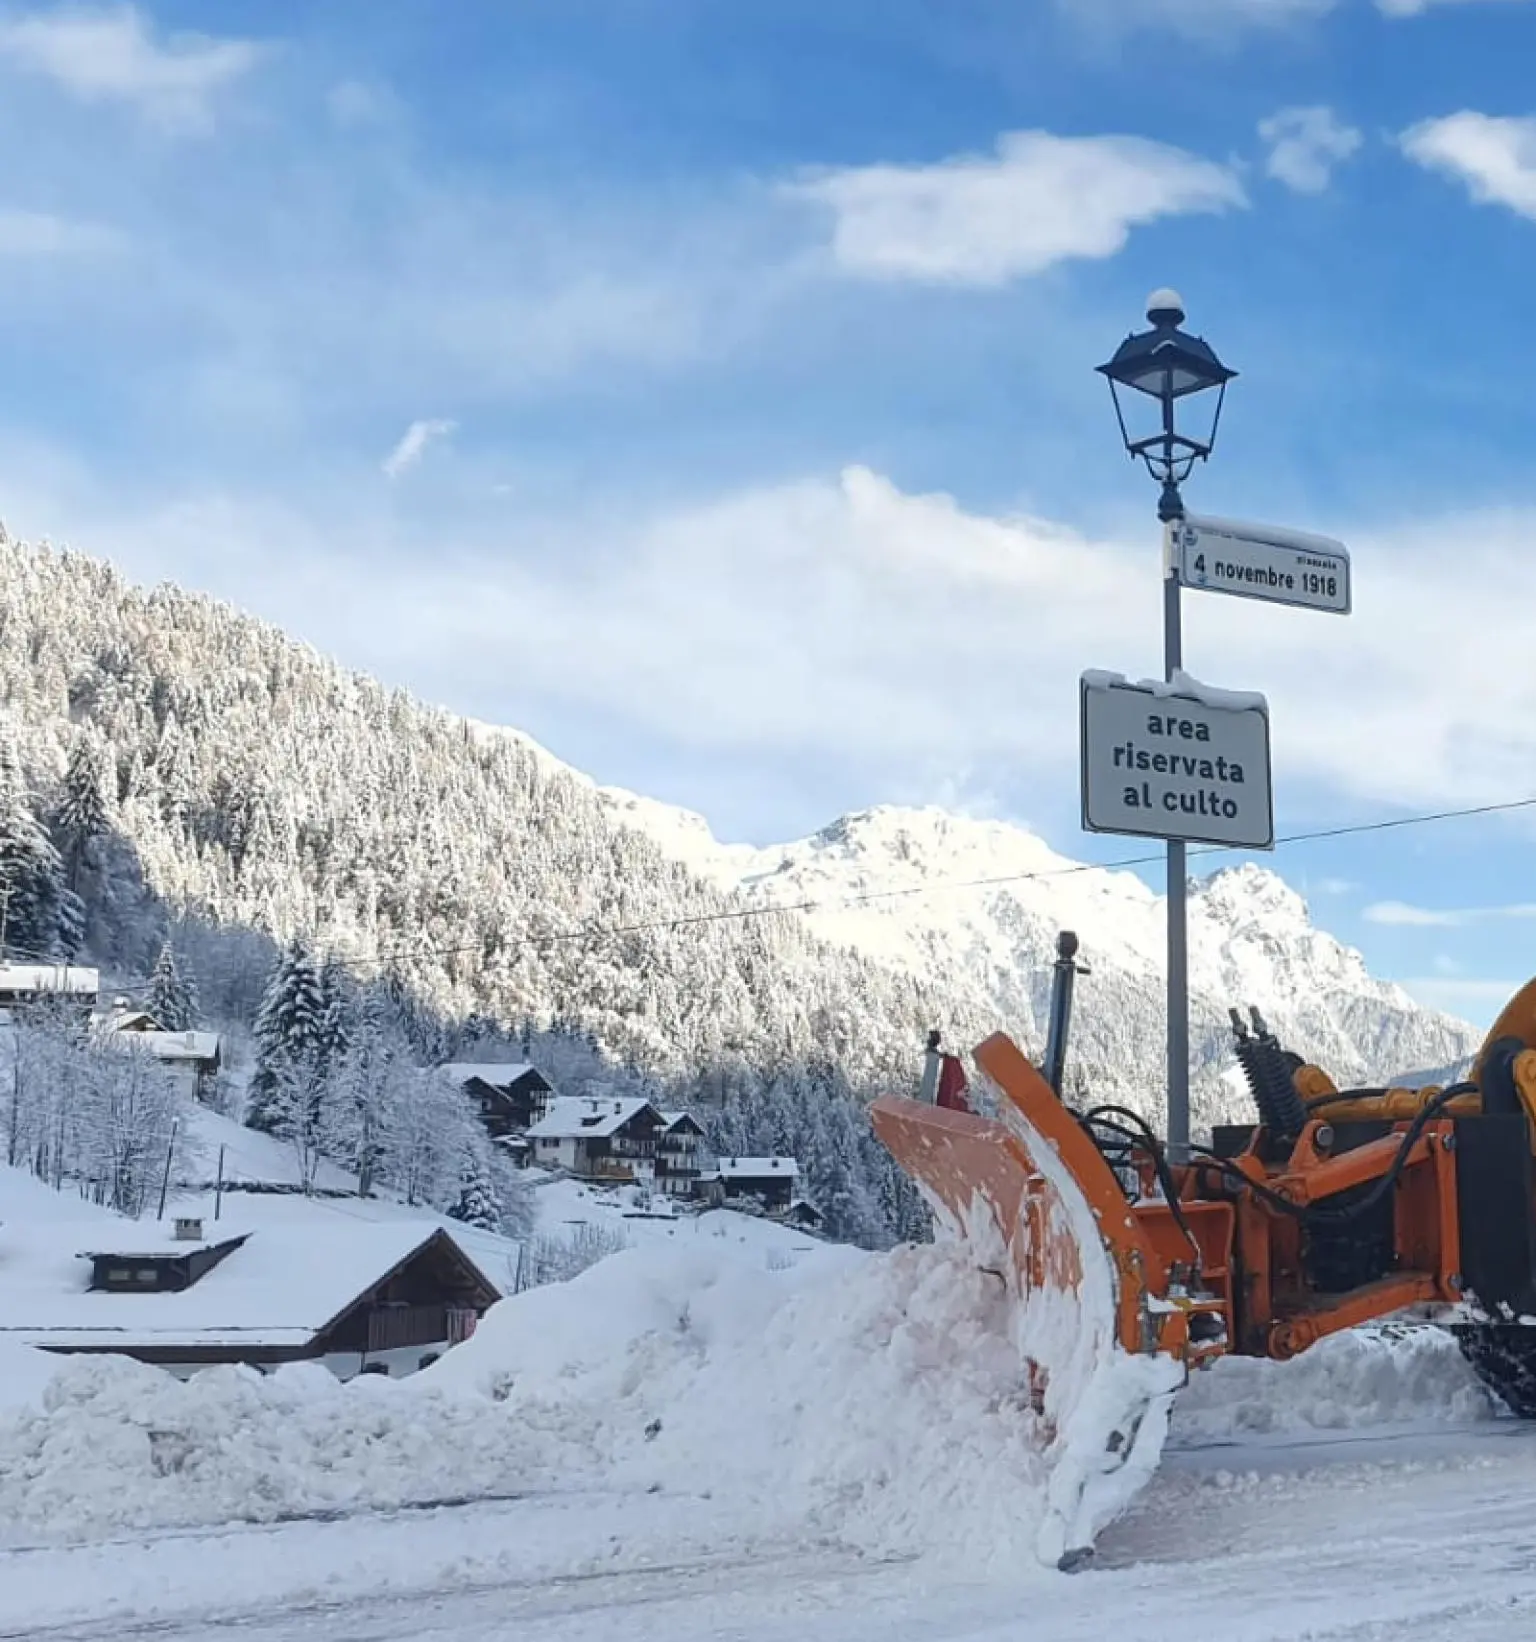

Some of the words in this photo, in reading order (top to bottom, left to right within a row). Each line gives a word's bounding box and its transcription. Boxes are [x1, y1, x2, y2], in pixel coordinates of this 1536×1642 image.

[1194, 554, 1205, 573] 4
[1214, 560, 1294, 590] novembre
[1302, 572, 1337, 598] 1918
[1147, 714, 1211, 742] area
[1112, 741, 1245, 784] riservata
[1122, 782, 1153, 809] al
[1162, 789, 1238, 819] culto
